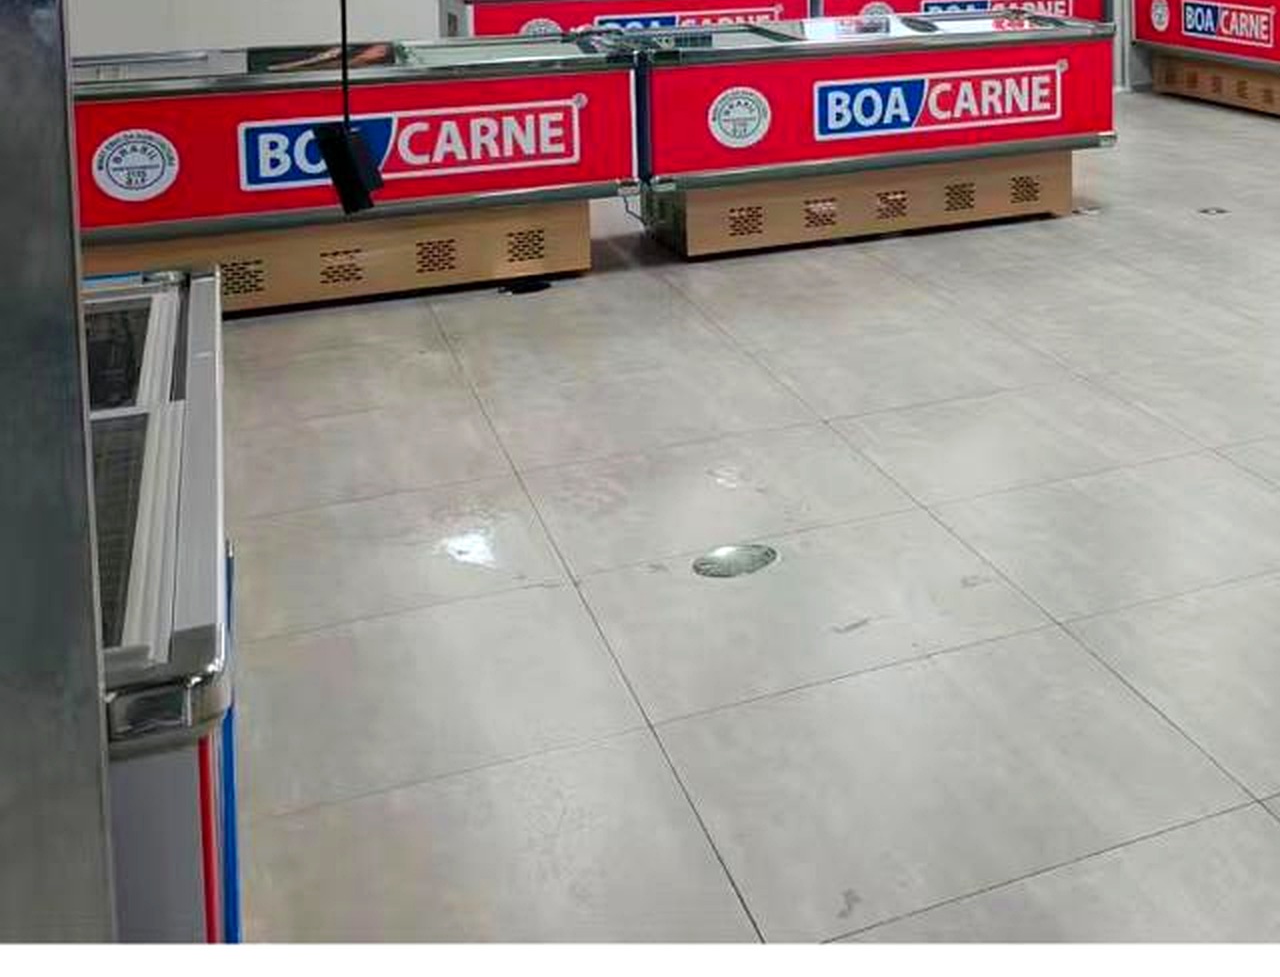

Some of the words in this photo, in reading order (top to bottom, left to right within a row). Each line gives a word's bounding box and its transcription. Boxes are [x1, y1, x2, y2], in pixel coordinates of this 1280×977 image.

[1185, 5, 1216, 32] BOA
[1220, 9, 1269, 41] CARNE
[827, 86, 912, 130] BOA
[927, 75, 1051, 120] CARNE
[258, 129, 361, 177] BO
[397, 111, 565, 165] CARNE
